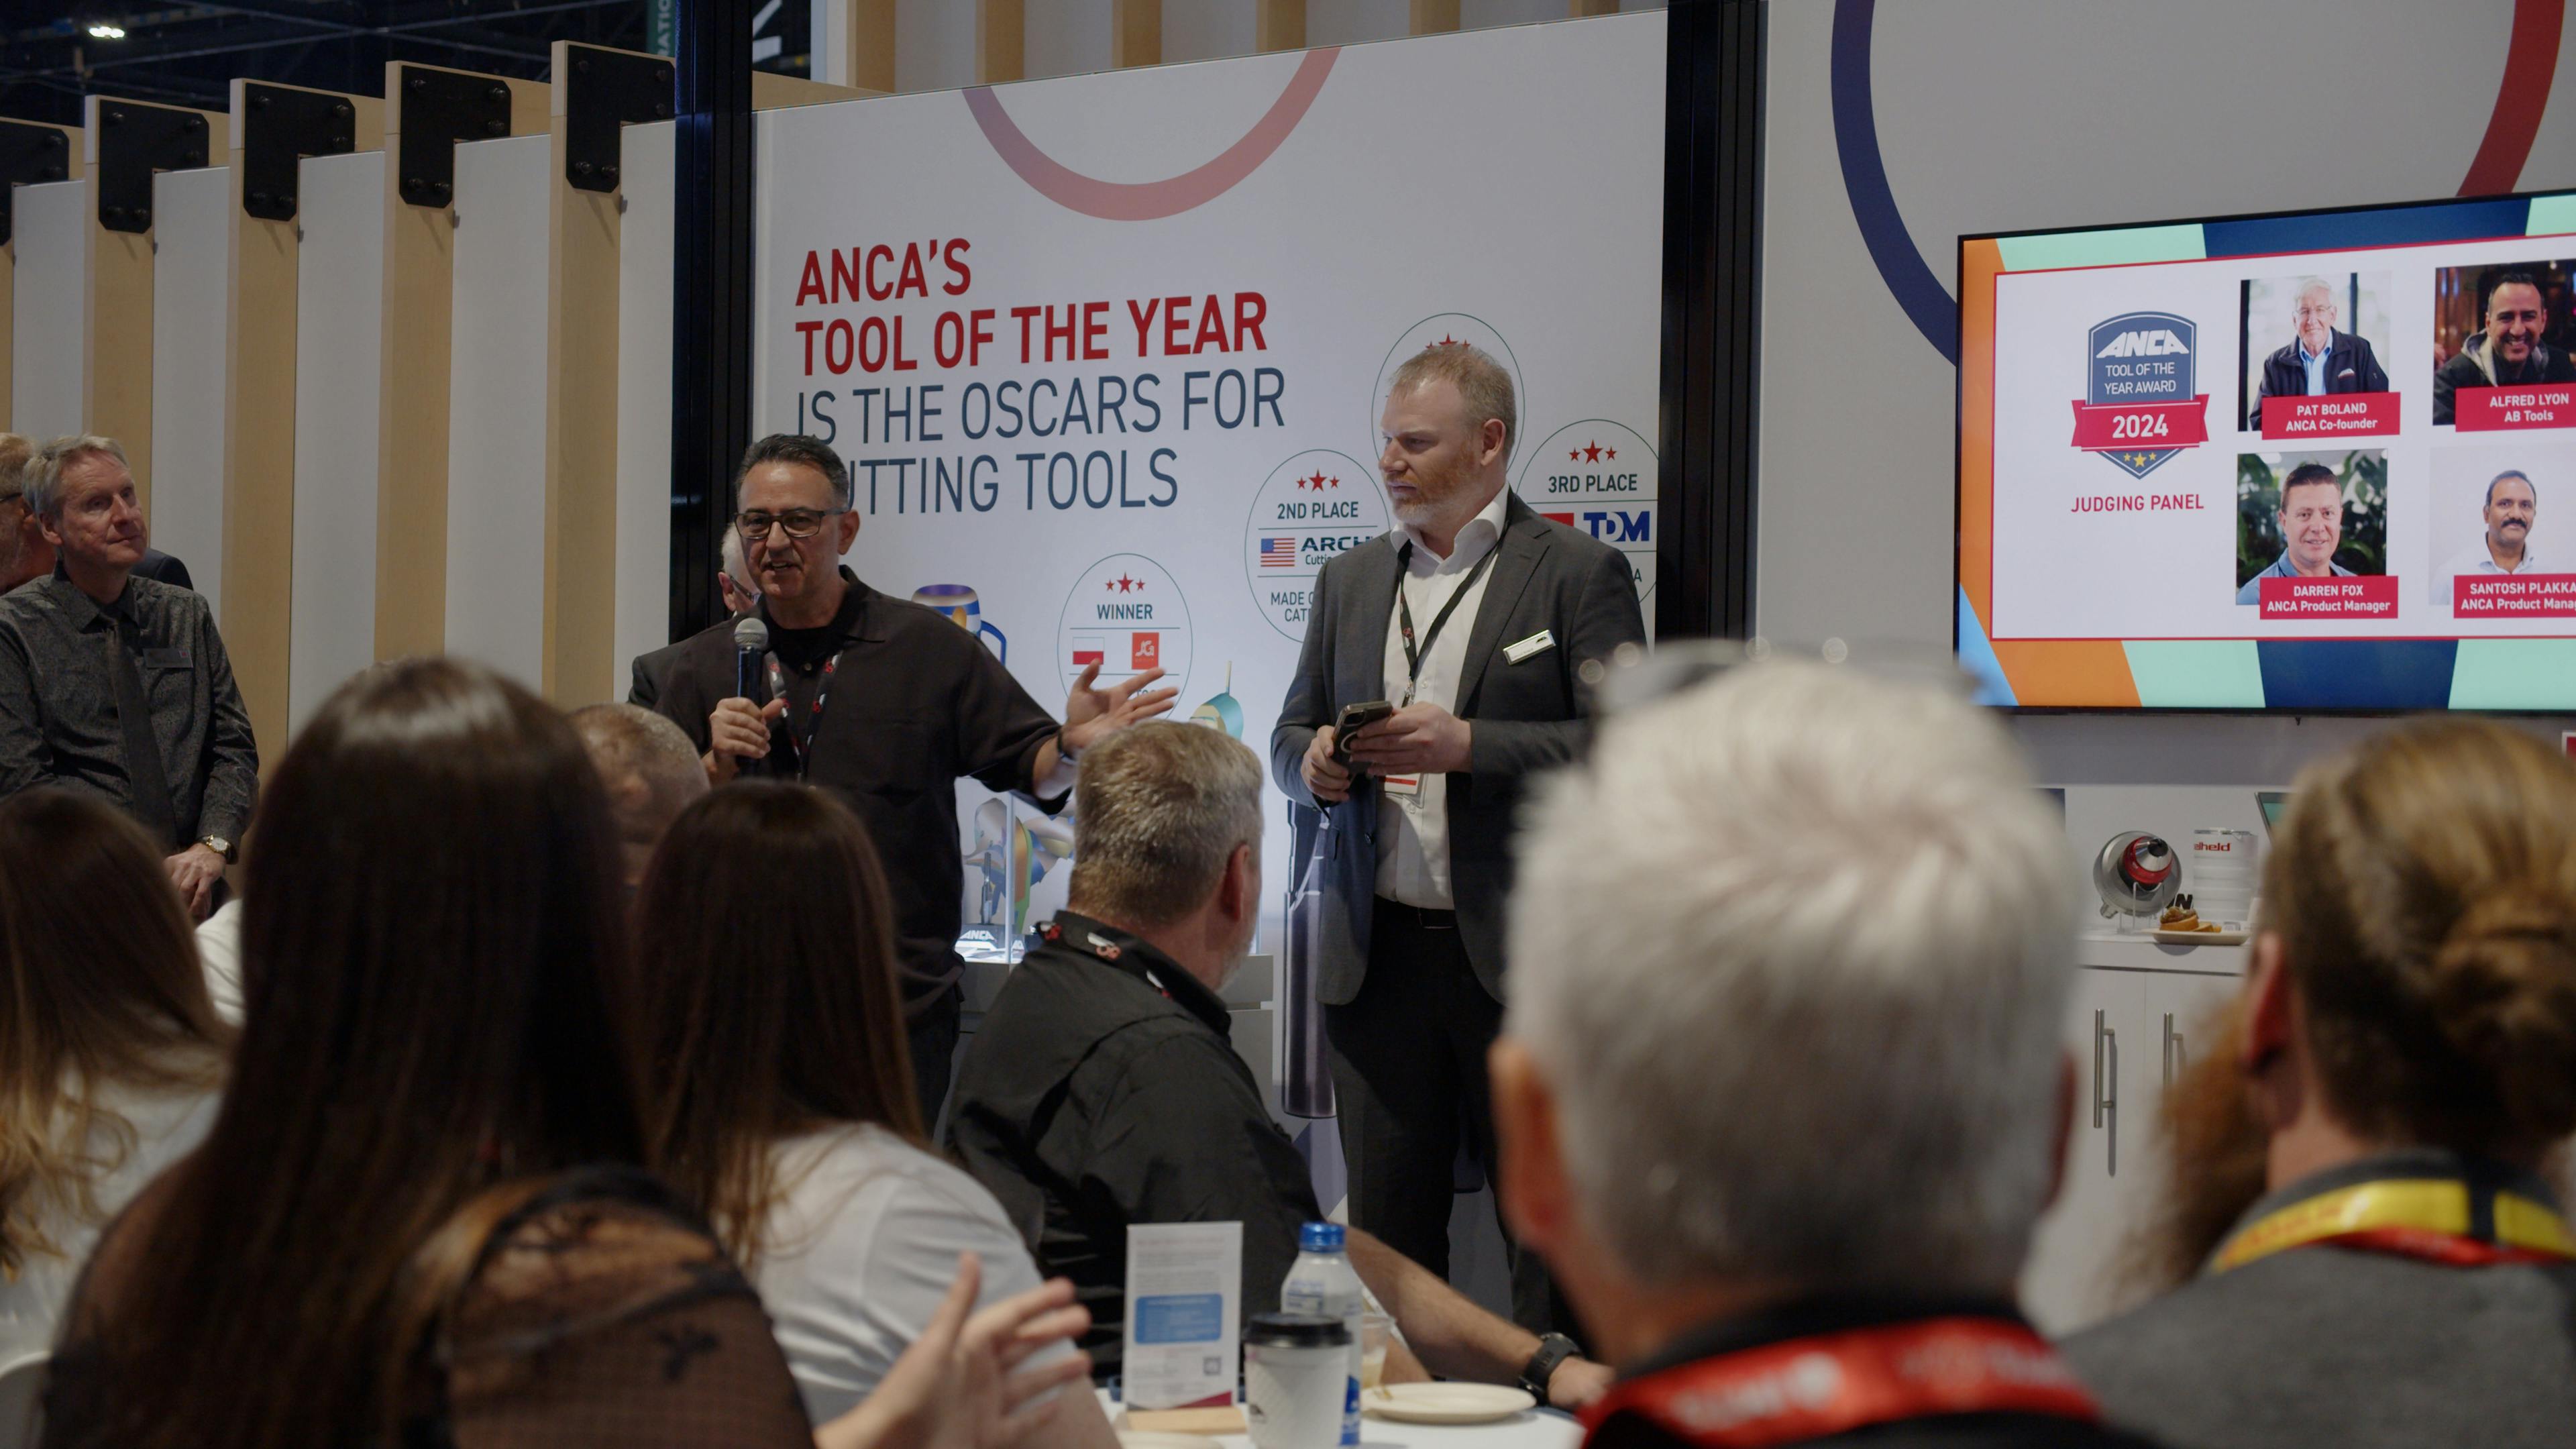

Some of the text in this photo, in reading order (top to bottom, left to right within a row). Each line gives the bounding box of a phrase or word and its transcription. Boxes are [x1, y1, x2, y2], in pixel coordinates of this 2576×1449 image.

[796, 238, 971, 306] ANCA'S
[796, 292, 1267, 376] TOOL OF THE YEAR
[2096, 329, 2190, 358] ANCA
[2105, 362, 2175, 377] TOOL OF THE
[2104, 380, 2176, 394] YEAR AWARD
[798, 368, 1285, 445] IS THE OSCARS FOR
[2489, 393, 2569, 407] ALFRED LYON
[2297, 402, 2367, 416] PAT BOLAND
[2504, 410, 2553, 422] AB Tools
[2112, 414, 2168, 438] 2024
[2286, 418, 2377, 431] ANCA Co-founder
[848, 448, 1179, 515] TTING TOOLS
[1548, 474, 1638, 493] 3RD PLACE
[1277, 502, 1358, 519] 2ND PLACE
[2071, 494, 2204, 512] JUDGING PANEL
[1583, 511, 1650, 542] TDM
[1305, 554, 1331, 565] Cutti
[2294, 585, 2363, 596] DARREN FOX
[2470, 582, 2576, 594] SANTOSH PLAKKA
[1271, 592, 1304, 605] MADE
[2461, 598, 2576, 611] ANCA Product Mana
[1097, 604, 1152, 619] WINNER
[2267, 600, 2391, 613] ANCA Product Manager
